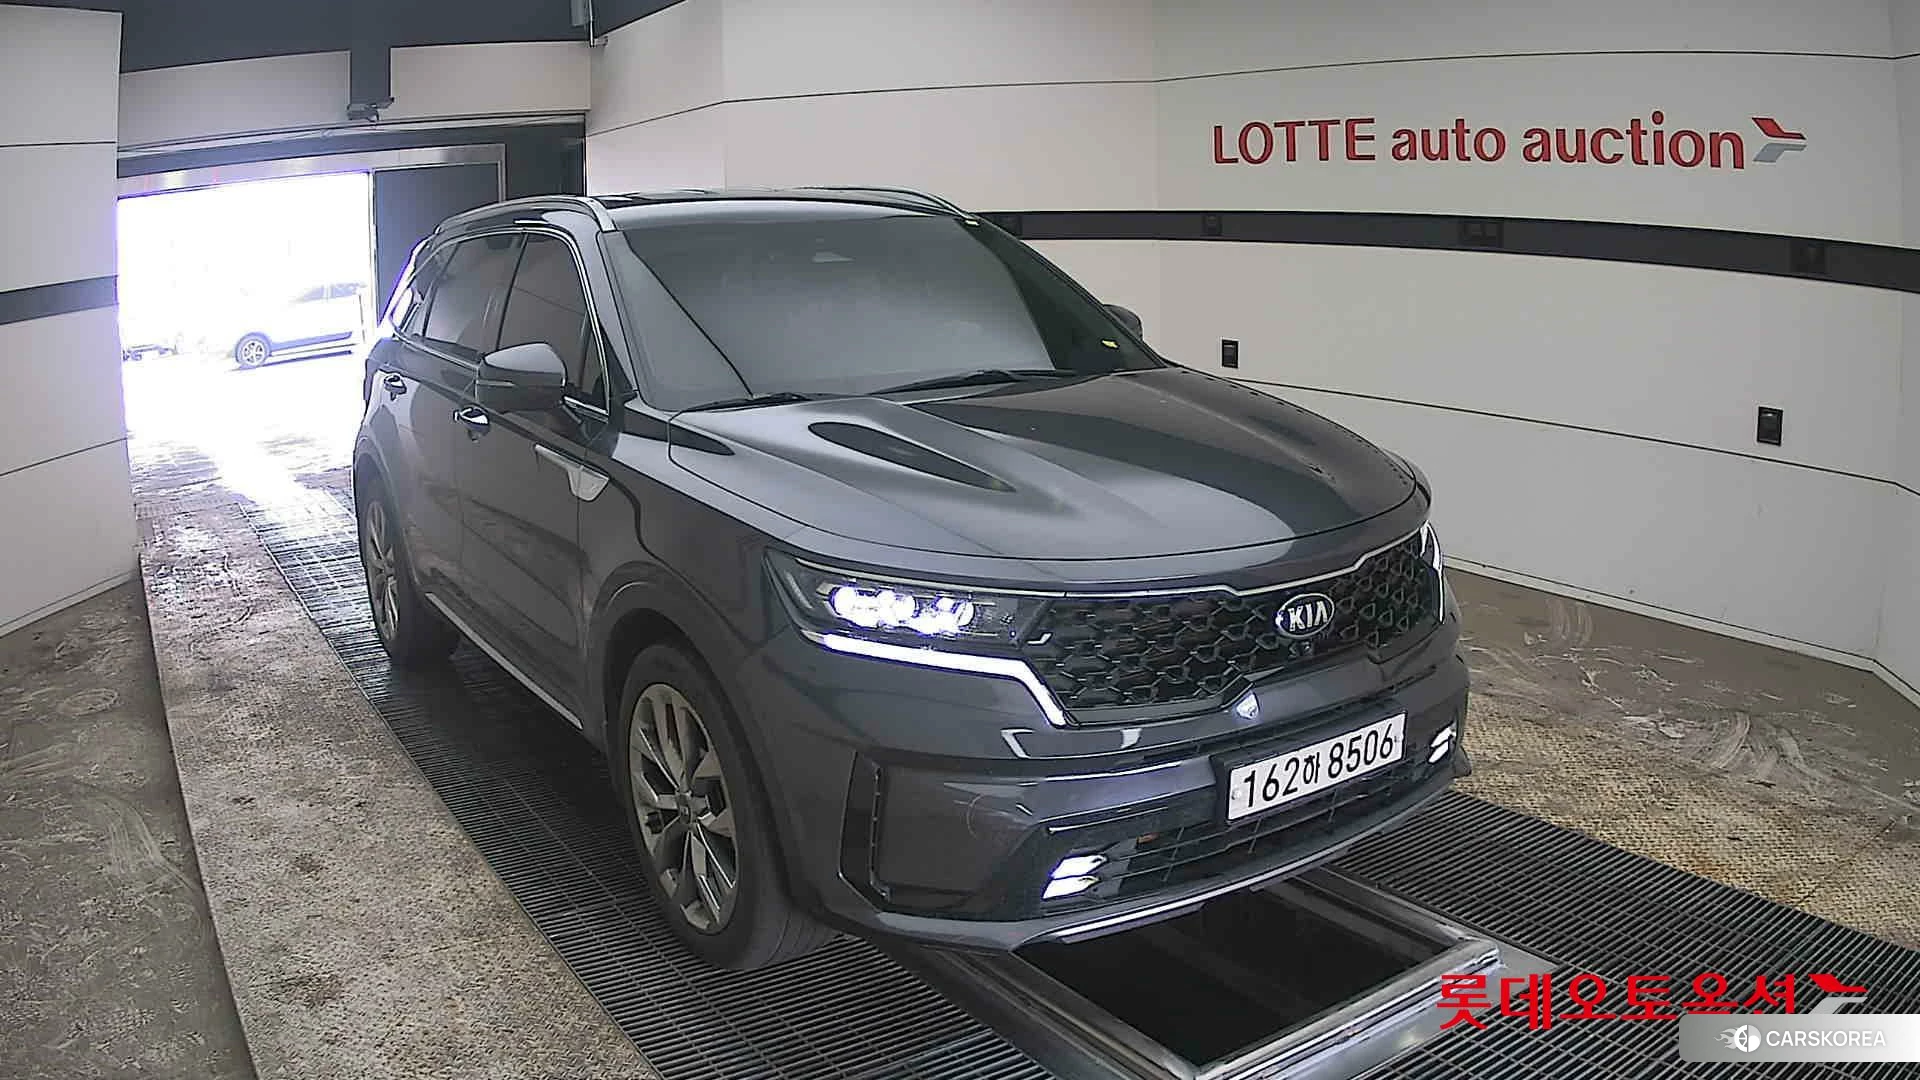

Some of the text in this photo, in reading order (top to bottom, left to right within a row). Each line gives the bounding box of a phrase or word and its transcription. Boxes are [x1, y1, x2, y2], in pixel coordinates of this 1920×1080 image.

[1213, 110, 1745, 170] LOTTE auto auction
[1287, 600, 1328, 632] KIA
[1243, 722, 1394, 809] 162하 8506
